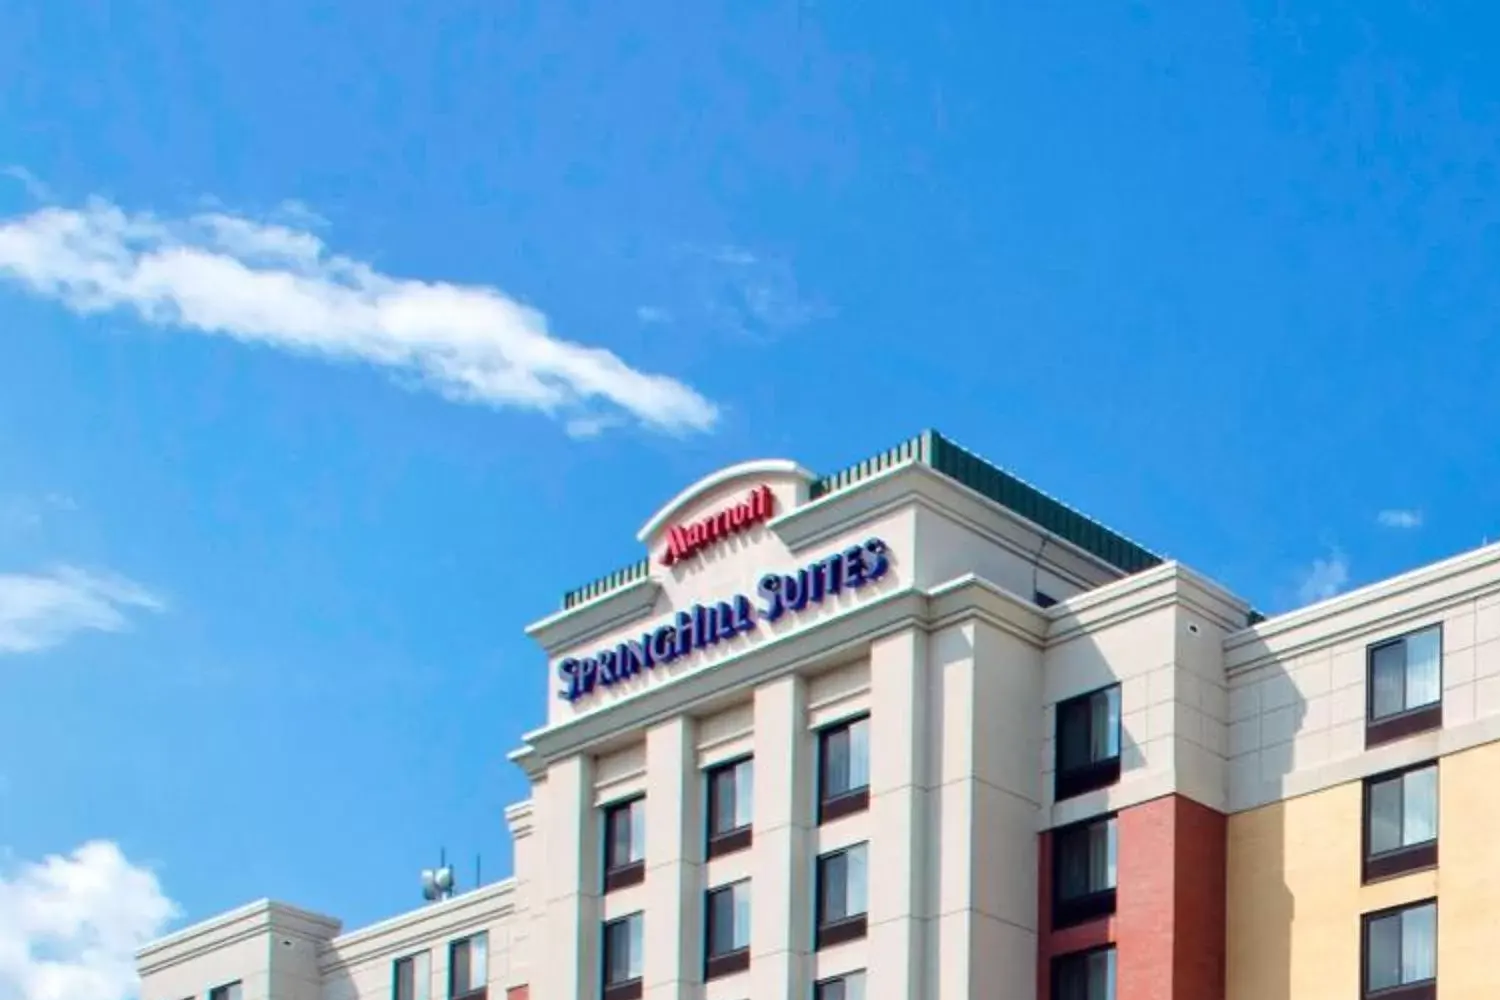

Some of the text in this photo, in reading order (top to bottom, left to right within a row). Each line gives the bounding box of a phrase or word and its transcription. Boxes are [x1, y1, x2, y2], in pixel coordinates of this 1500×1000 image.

[660, 484, 776, 566] Marriott
[558, 537, 893, 702] SPRINGHILL SUITES
